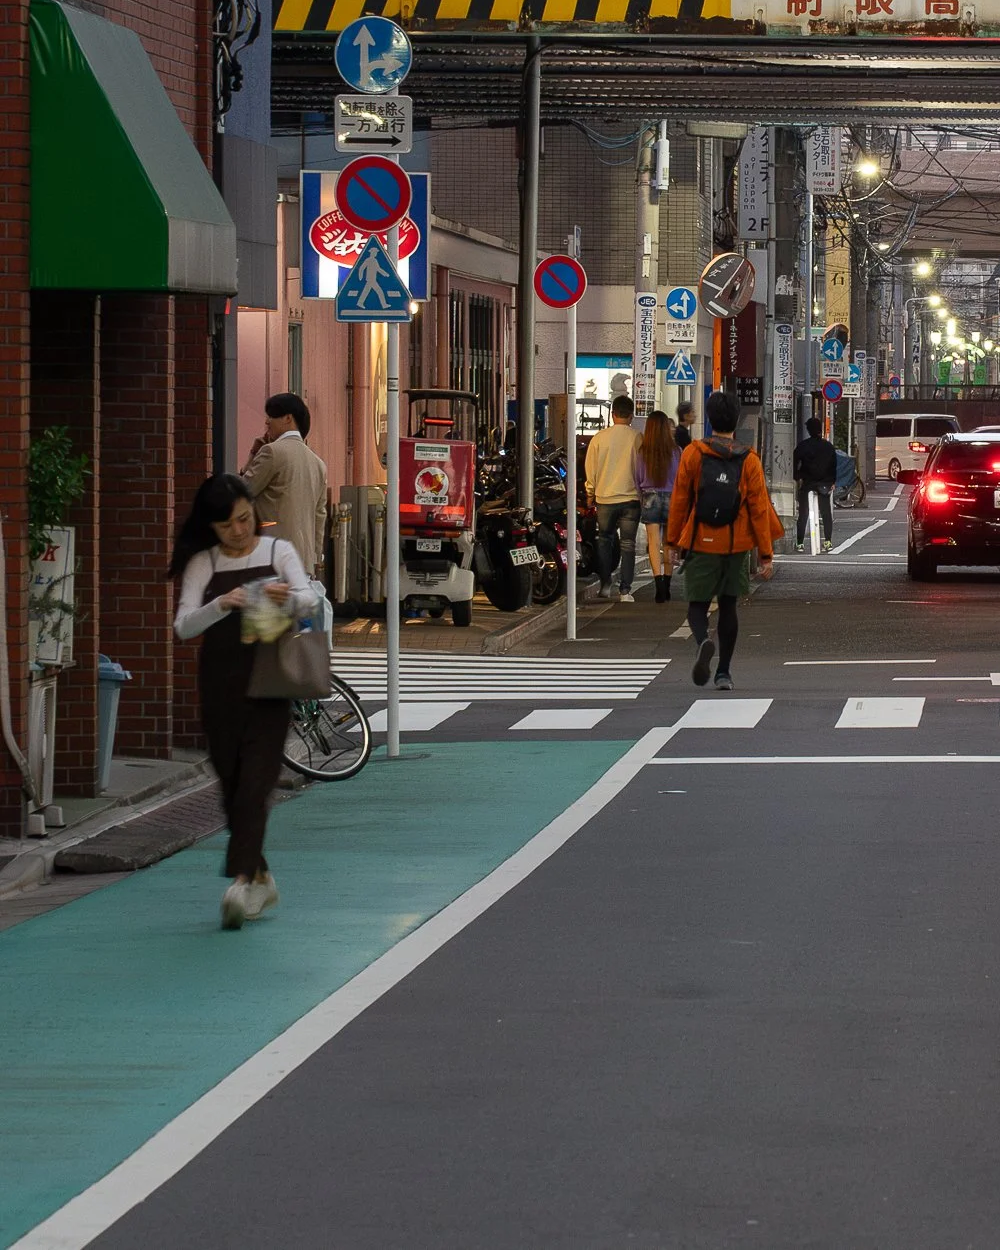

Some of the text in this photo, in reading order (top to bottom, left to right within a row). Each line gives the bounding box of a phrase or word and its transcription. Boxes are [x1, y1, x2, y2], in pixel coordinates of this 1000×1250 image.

[341, 102, 405, 117] 自転車を除く
[341, 119, 405, 133] 一方通行
[813, 132, 821, 171] センター
[640, 298, 656, 306] JEC
[641, 308, 653, 372] 宝石取引センター
[730, 314, 738, 372] ーネユナイテッド
